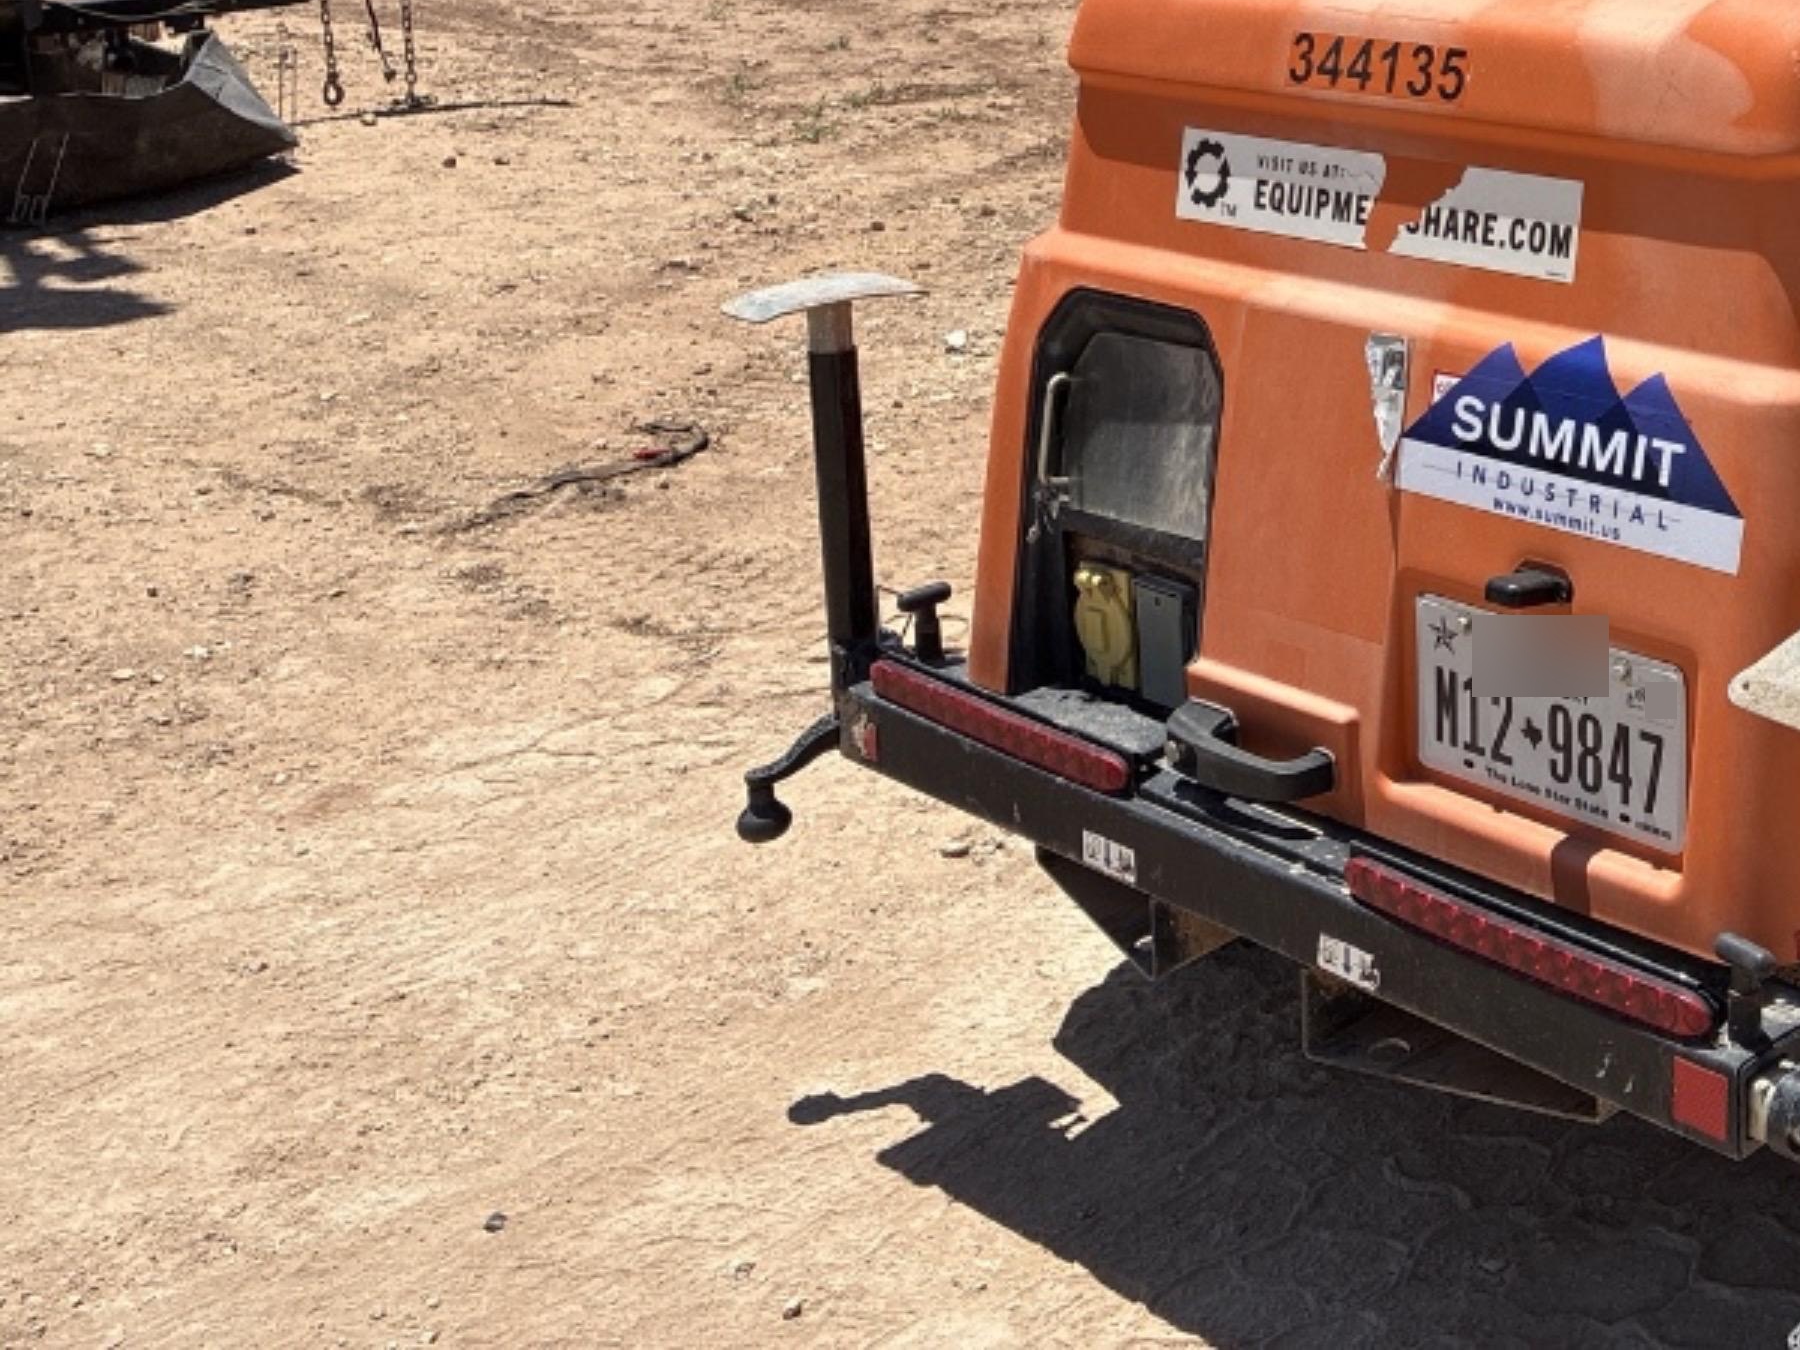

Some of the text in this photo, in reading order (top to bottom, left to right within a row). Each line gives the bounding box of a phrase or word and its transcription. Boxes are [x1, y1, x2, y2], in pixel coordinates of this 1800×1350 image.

[1288, 31, 1468, 102] 344135
[1258, 154, 1294, 173] VISIT
[1253, 179, 1574, 260] EQUIPMEHARE.COM
[1451, 395, 1687, 488] SUMMIT
[1456, 460, 1669, 531] INDUSTRIAL
[1493, 496, 1622, 540] www.summit.us
